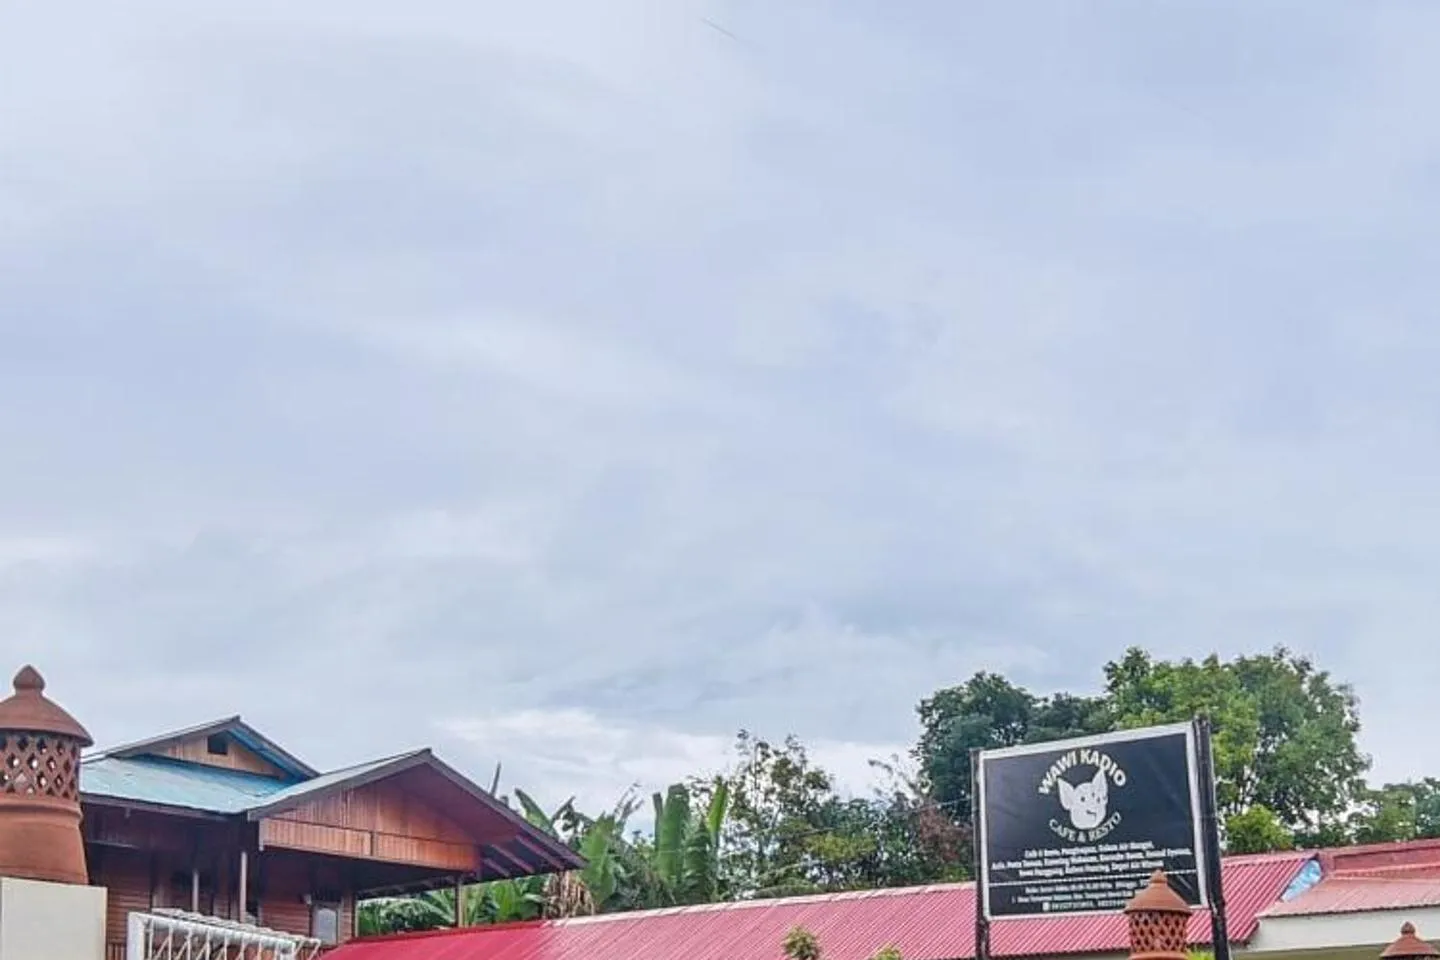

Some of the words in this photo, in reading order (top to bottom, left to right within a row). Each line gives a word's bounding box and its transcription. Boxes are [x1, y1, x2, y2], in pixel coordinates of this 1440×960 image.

[1038, 750, 1077, 794] WAWI
[1080, 749, 1126, 787] KADIO
[1088, 811, 1122, 841] RESTO
